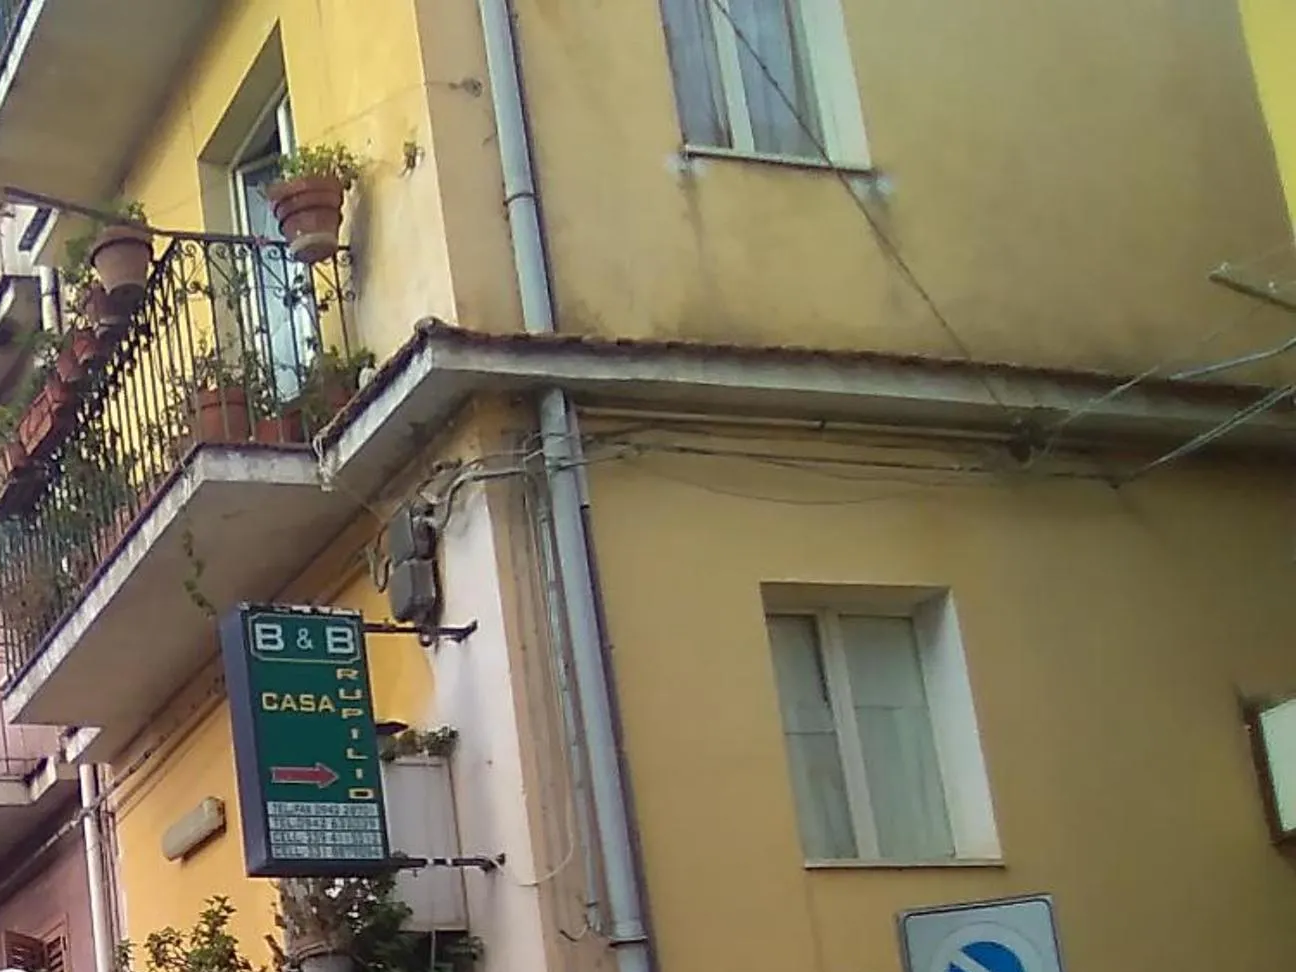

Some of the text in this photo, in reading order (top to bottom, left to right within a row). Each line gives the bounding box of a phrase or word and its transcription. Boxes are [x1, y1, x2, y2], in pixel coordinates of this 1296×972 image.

[254, 623, 354, 654] B & B
[261, 692, 336, 713] CASA
[336, 668, 374, 800] RUPILIO
